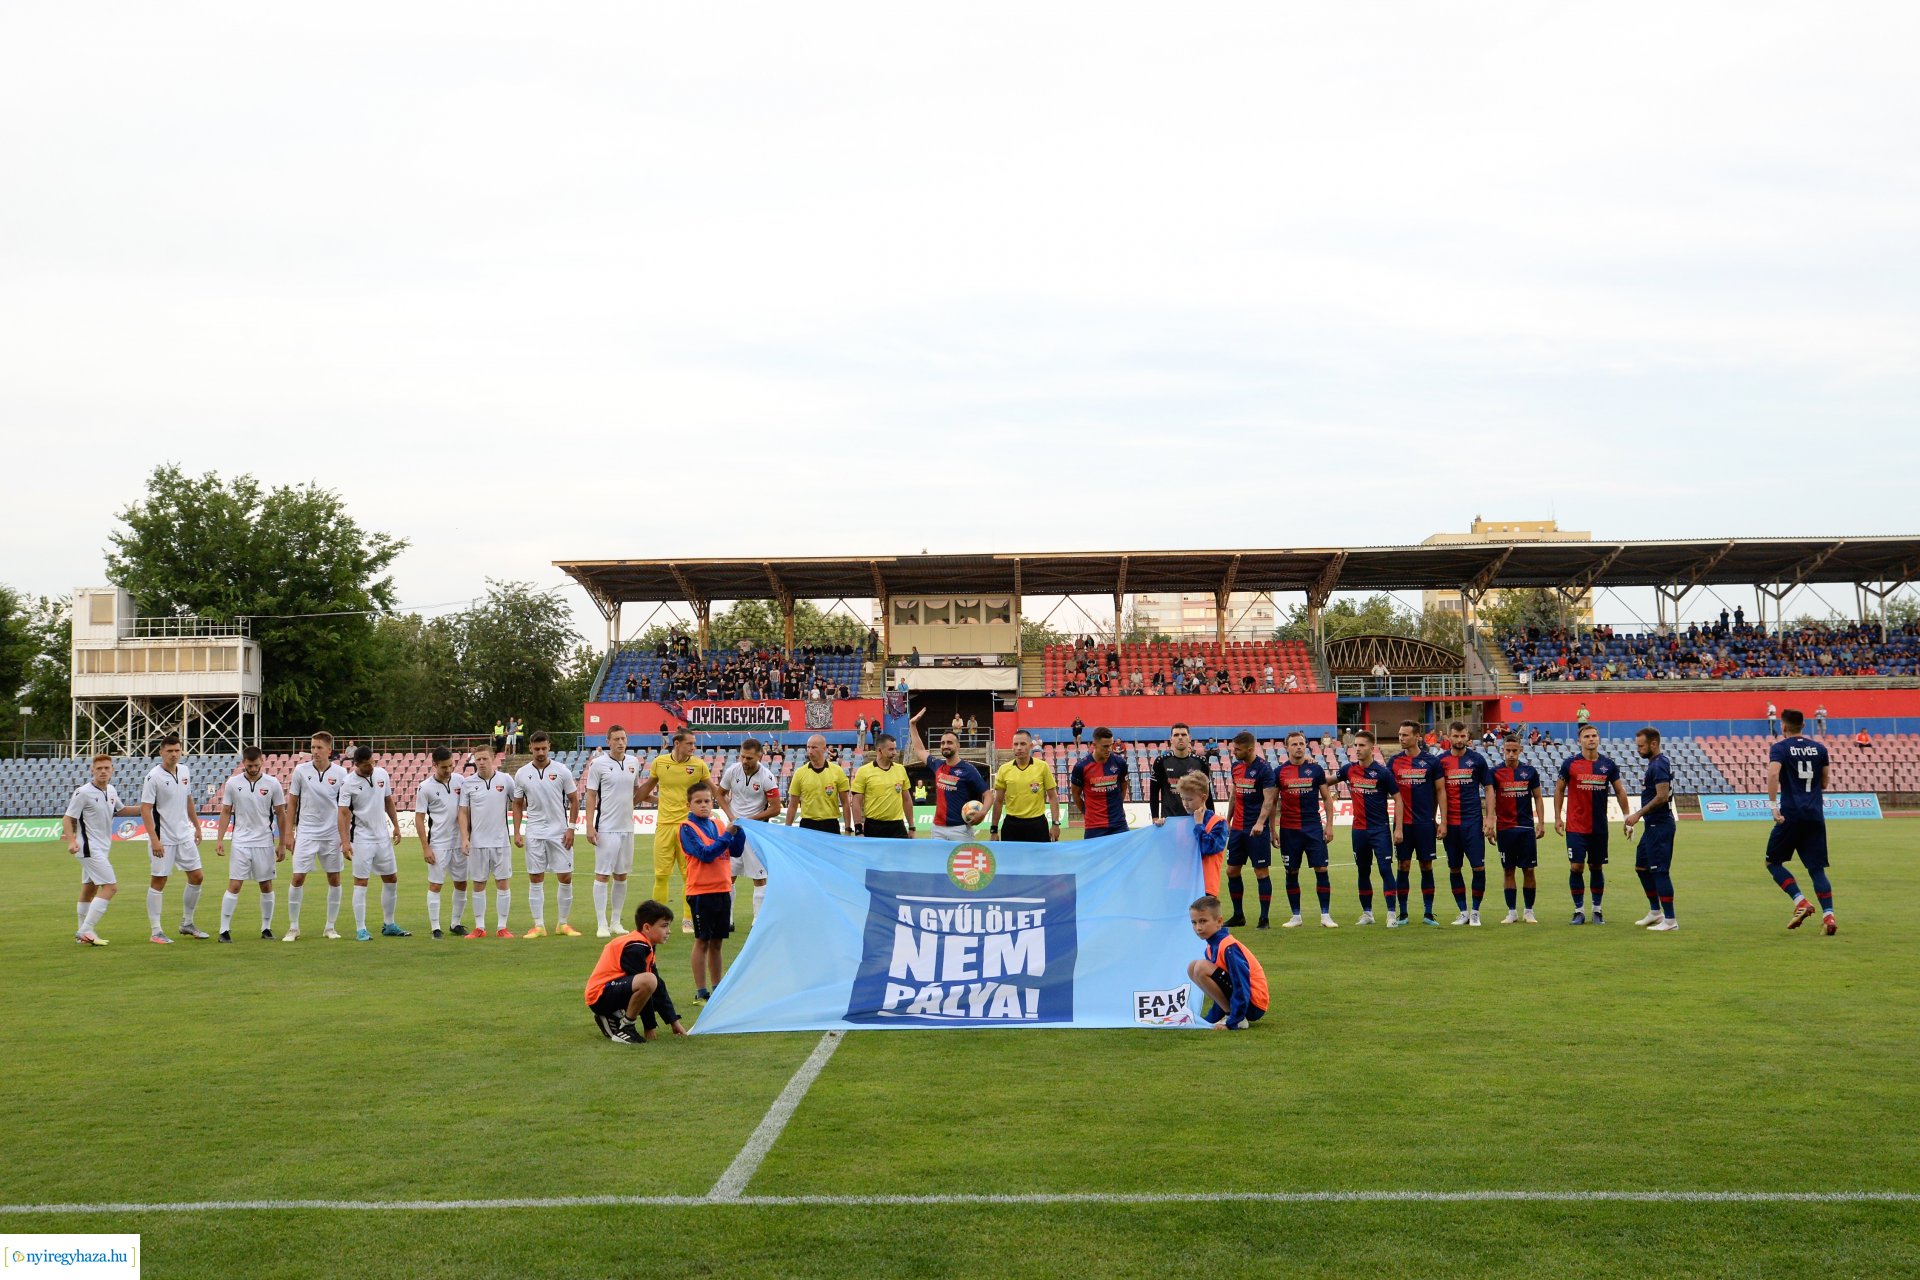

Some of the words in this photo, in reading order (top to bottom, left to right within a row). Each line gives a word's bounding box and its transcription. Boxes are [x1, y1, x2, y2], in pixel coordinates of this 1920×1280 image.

[692, 703, 783, 725] NYÍREGYHÁZA
[1790, 746, 1818, 756] ÖTVÖS
[1798, 761, 1814, 793] 4
[897, 904, 915, 927] A
[919, 903, 1046, 934] GYŰLÖLET
[888, 923, 1046, 982] NEM
[882, 982, 1041, 1018] PÁLYA!
[1138, 988, 1186, 1008] FAIR
